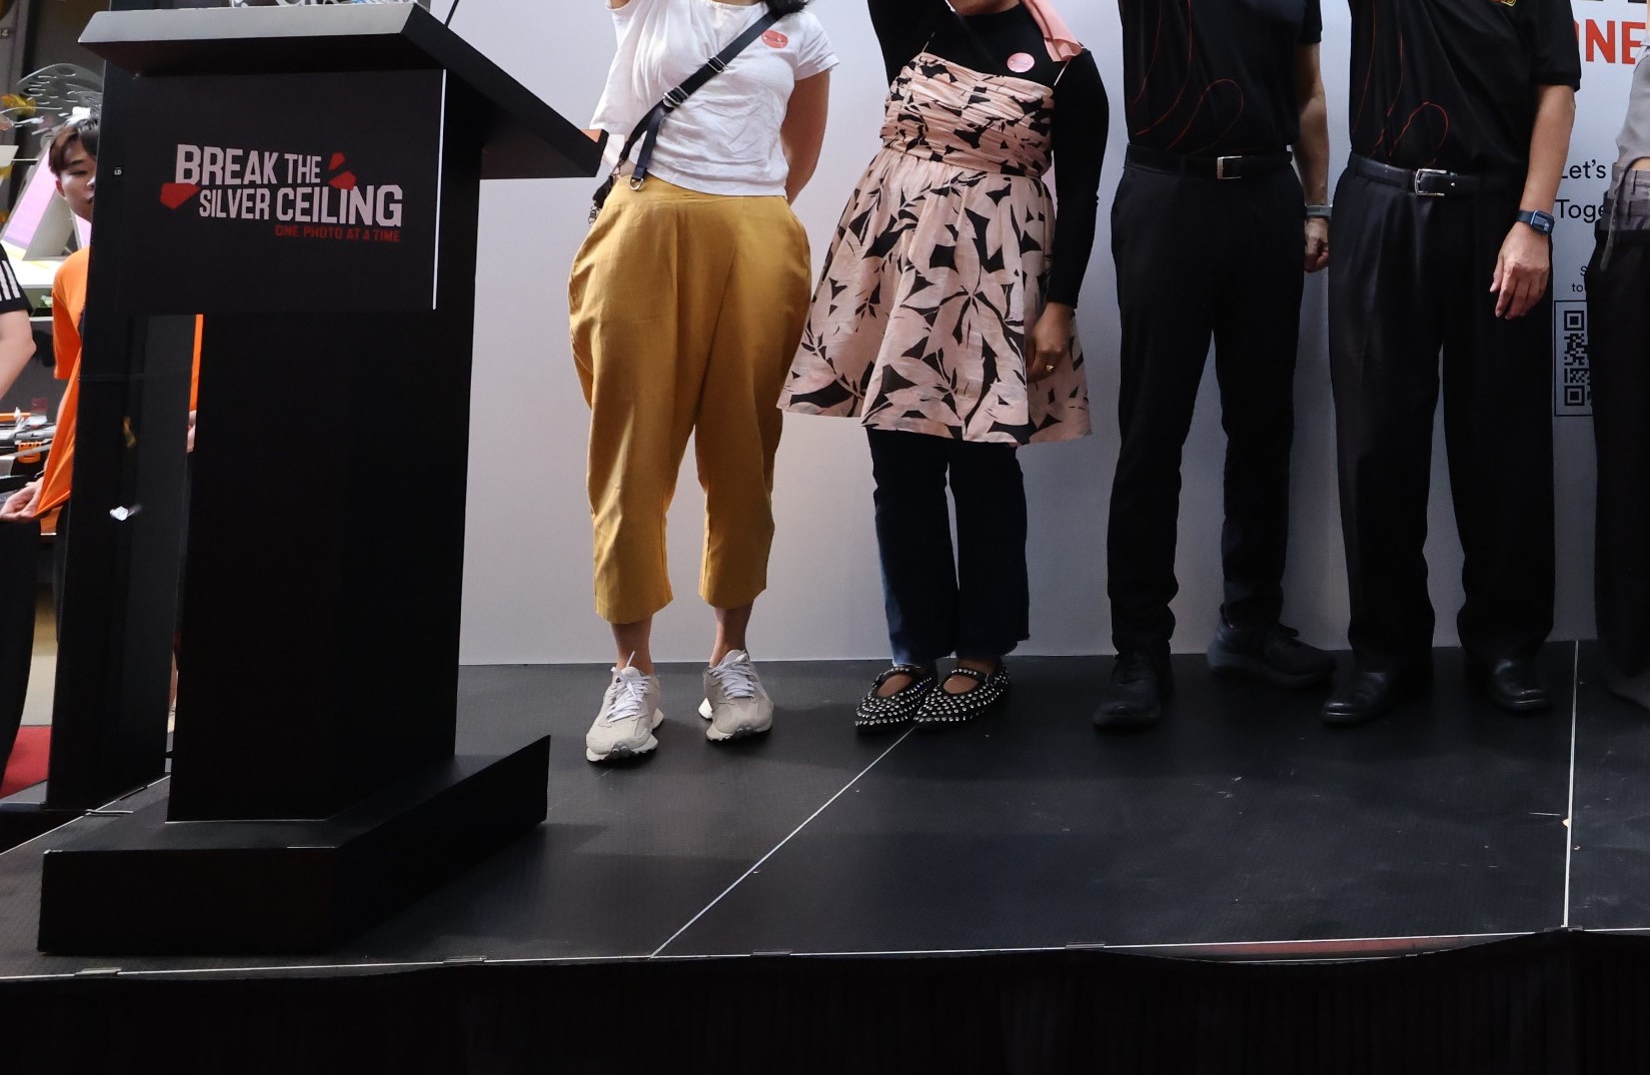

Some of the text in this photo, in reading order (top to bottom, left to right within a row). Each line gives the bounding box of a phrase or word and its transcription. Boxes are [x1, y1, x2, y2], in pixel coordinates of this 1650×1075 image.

[174, 143, 322, 186] BREAK THE
[199, 184, 404, 228] SILVER CEILING
[274, 224, 400, 243] ONE PHOTO AT A TIME
